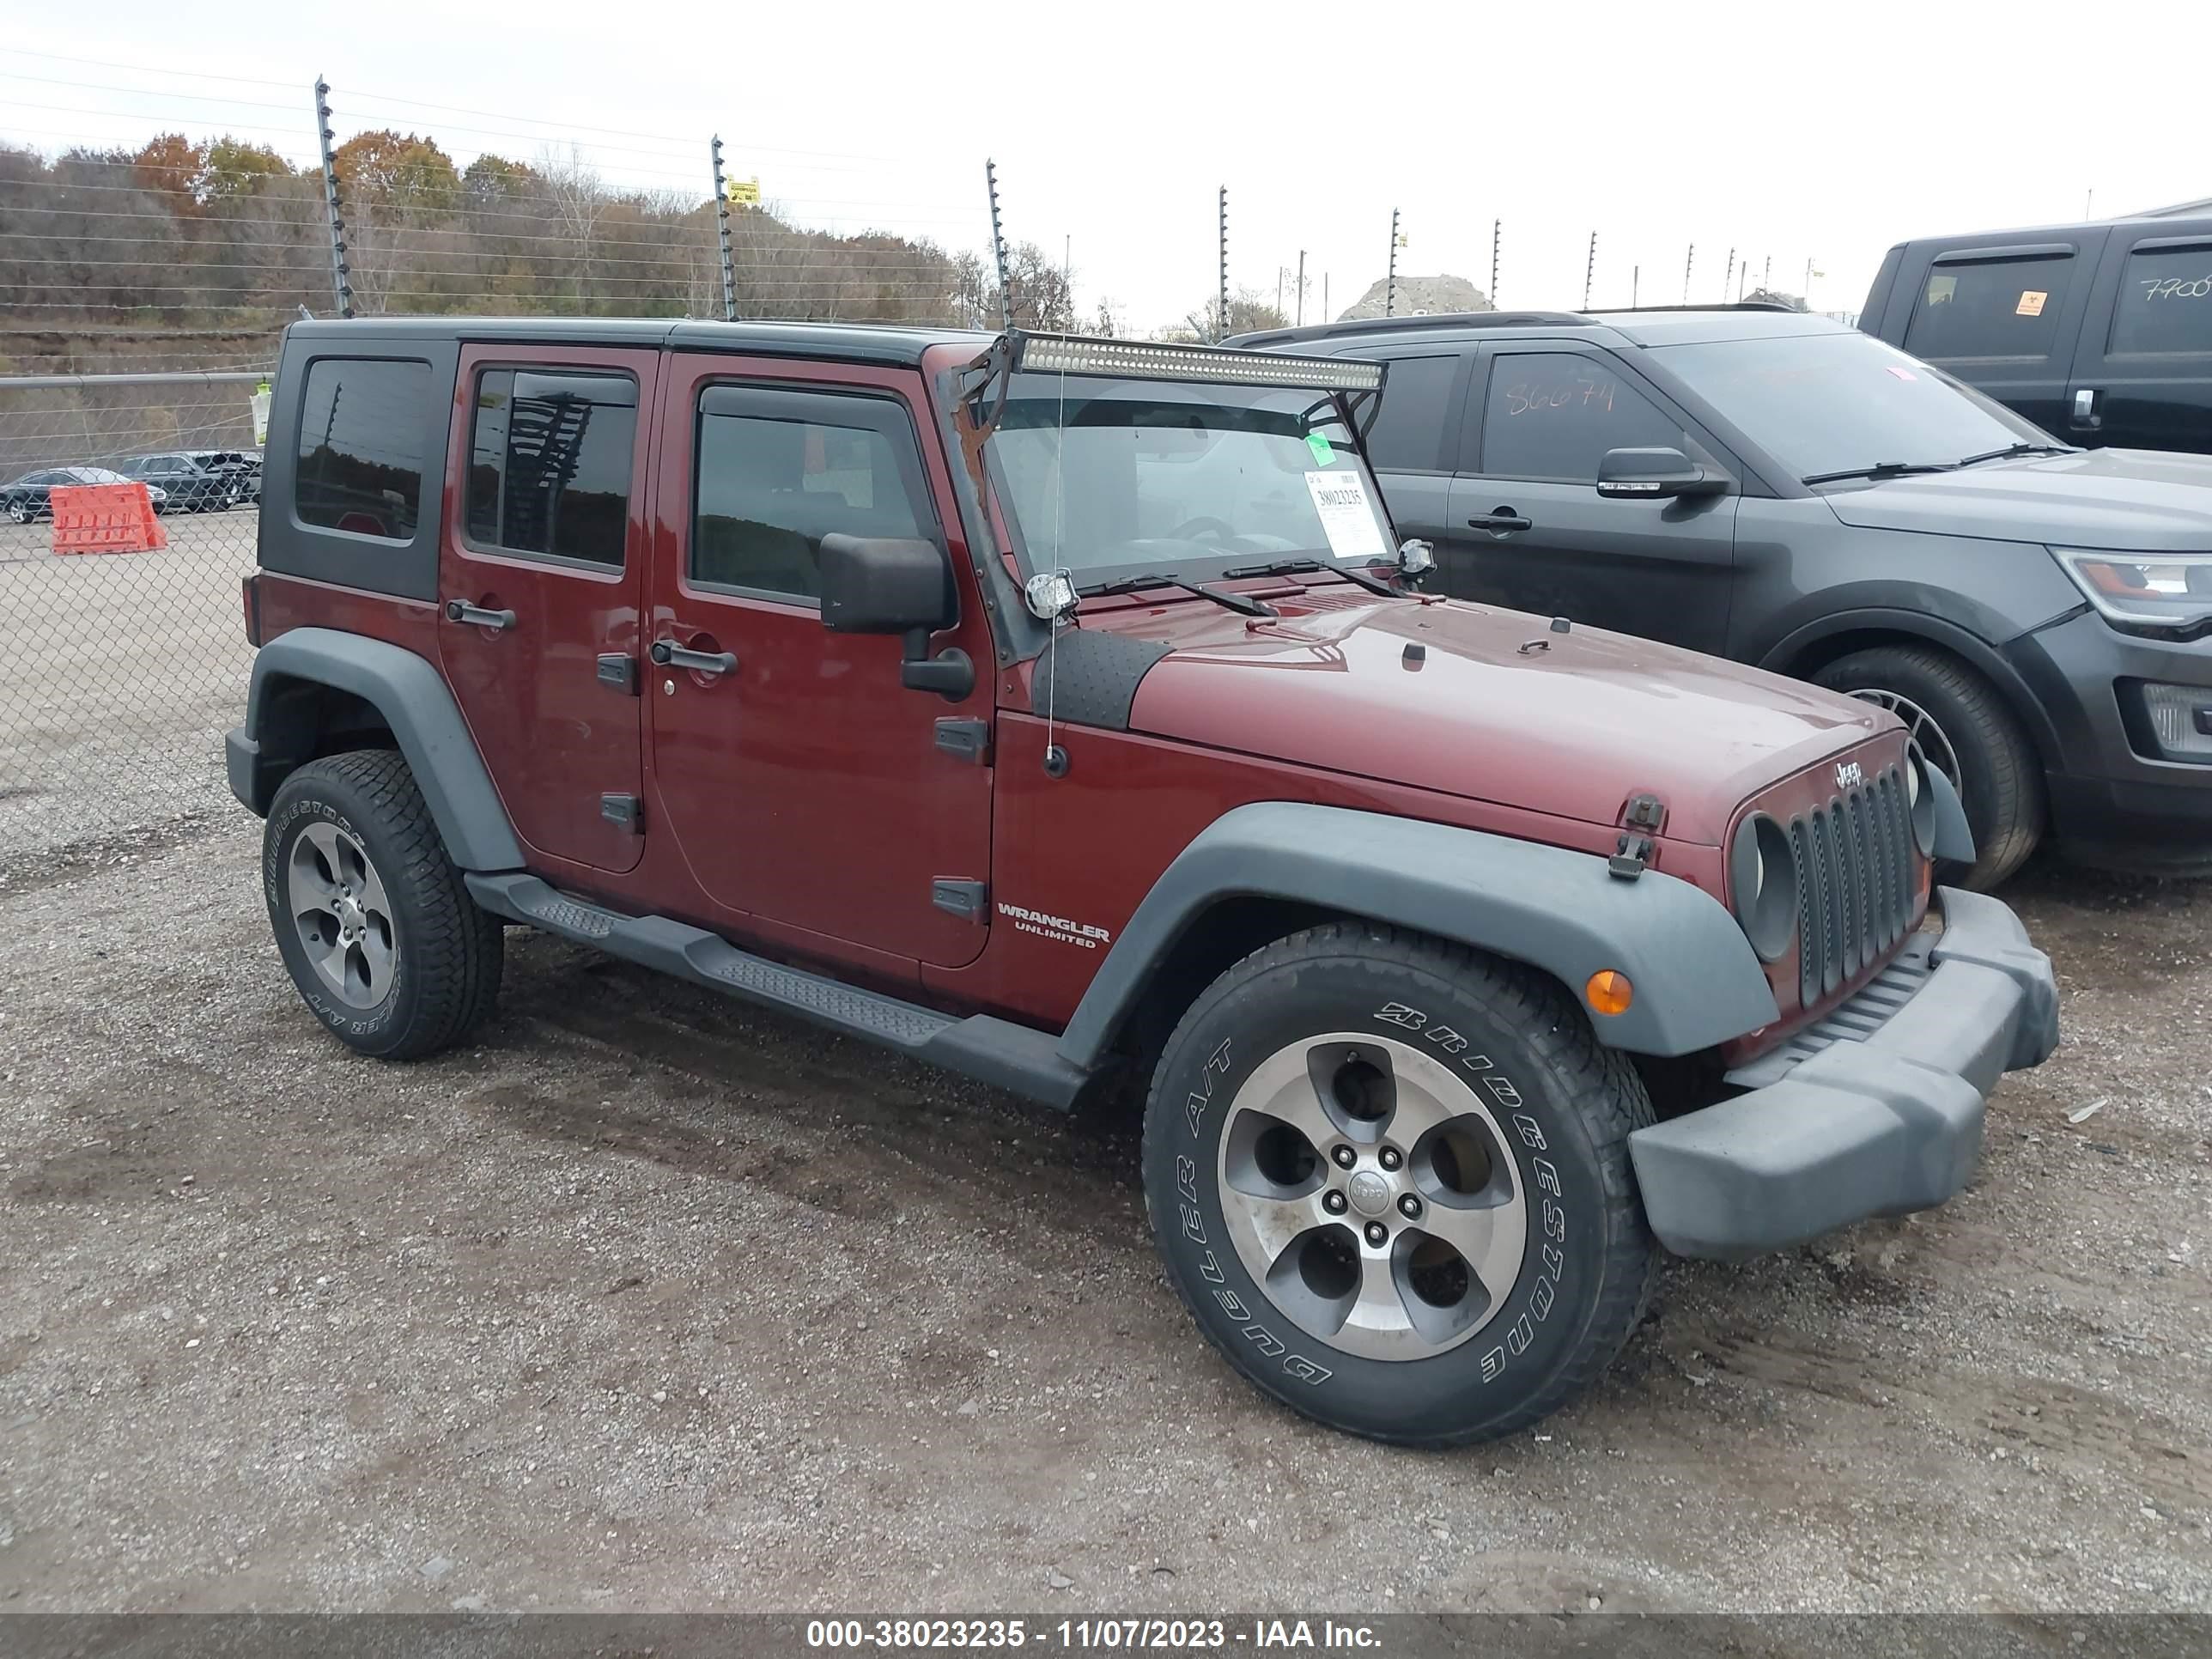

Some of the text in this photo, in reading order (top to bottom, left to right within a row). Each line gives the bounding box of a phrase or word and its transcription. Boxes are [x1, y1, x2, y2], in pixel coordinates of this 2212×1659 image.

[1317, 489, 1363, 507] 38023235
[1836, 762, 1862, 789] Jeep
[998, 902, 1111, 944] WRANGLER
[1015, 921, 1097, 950] UNLIMITED
[1373, 1001, 1566, 1384] BRIDGESTONE
[1176, 1036, 1333, 1385] DUELER A/T
